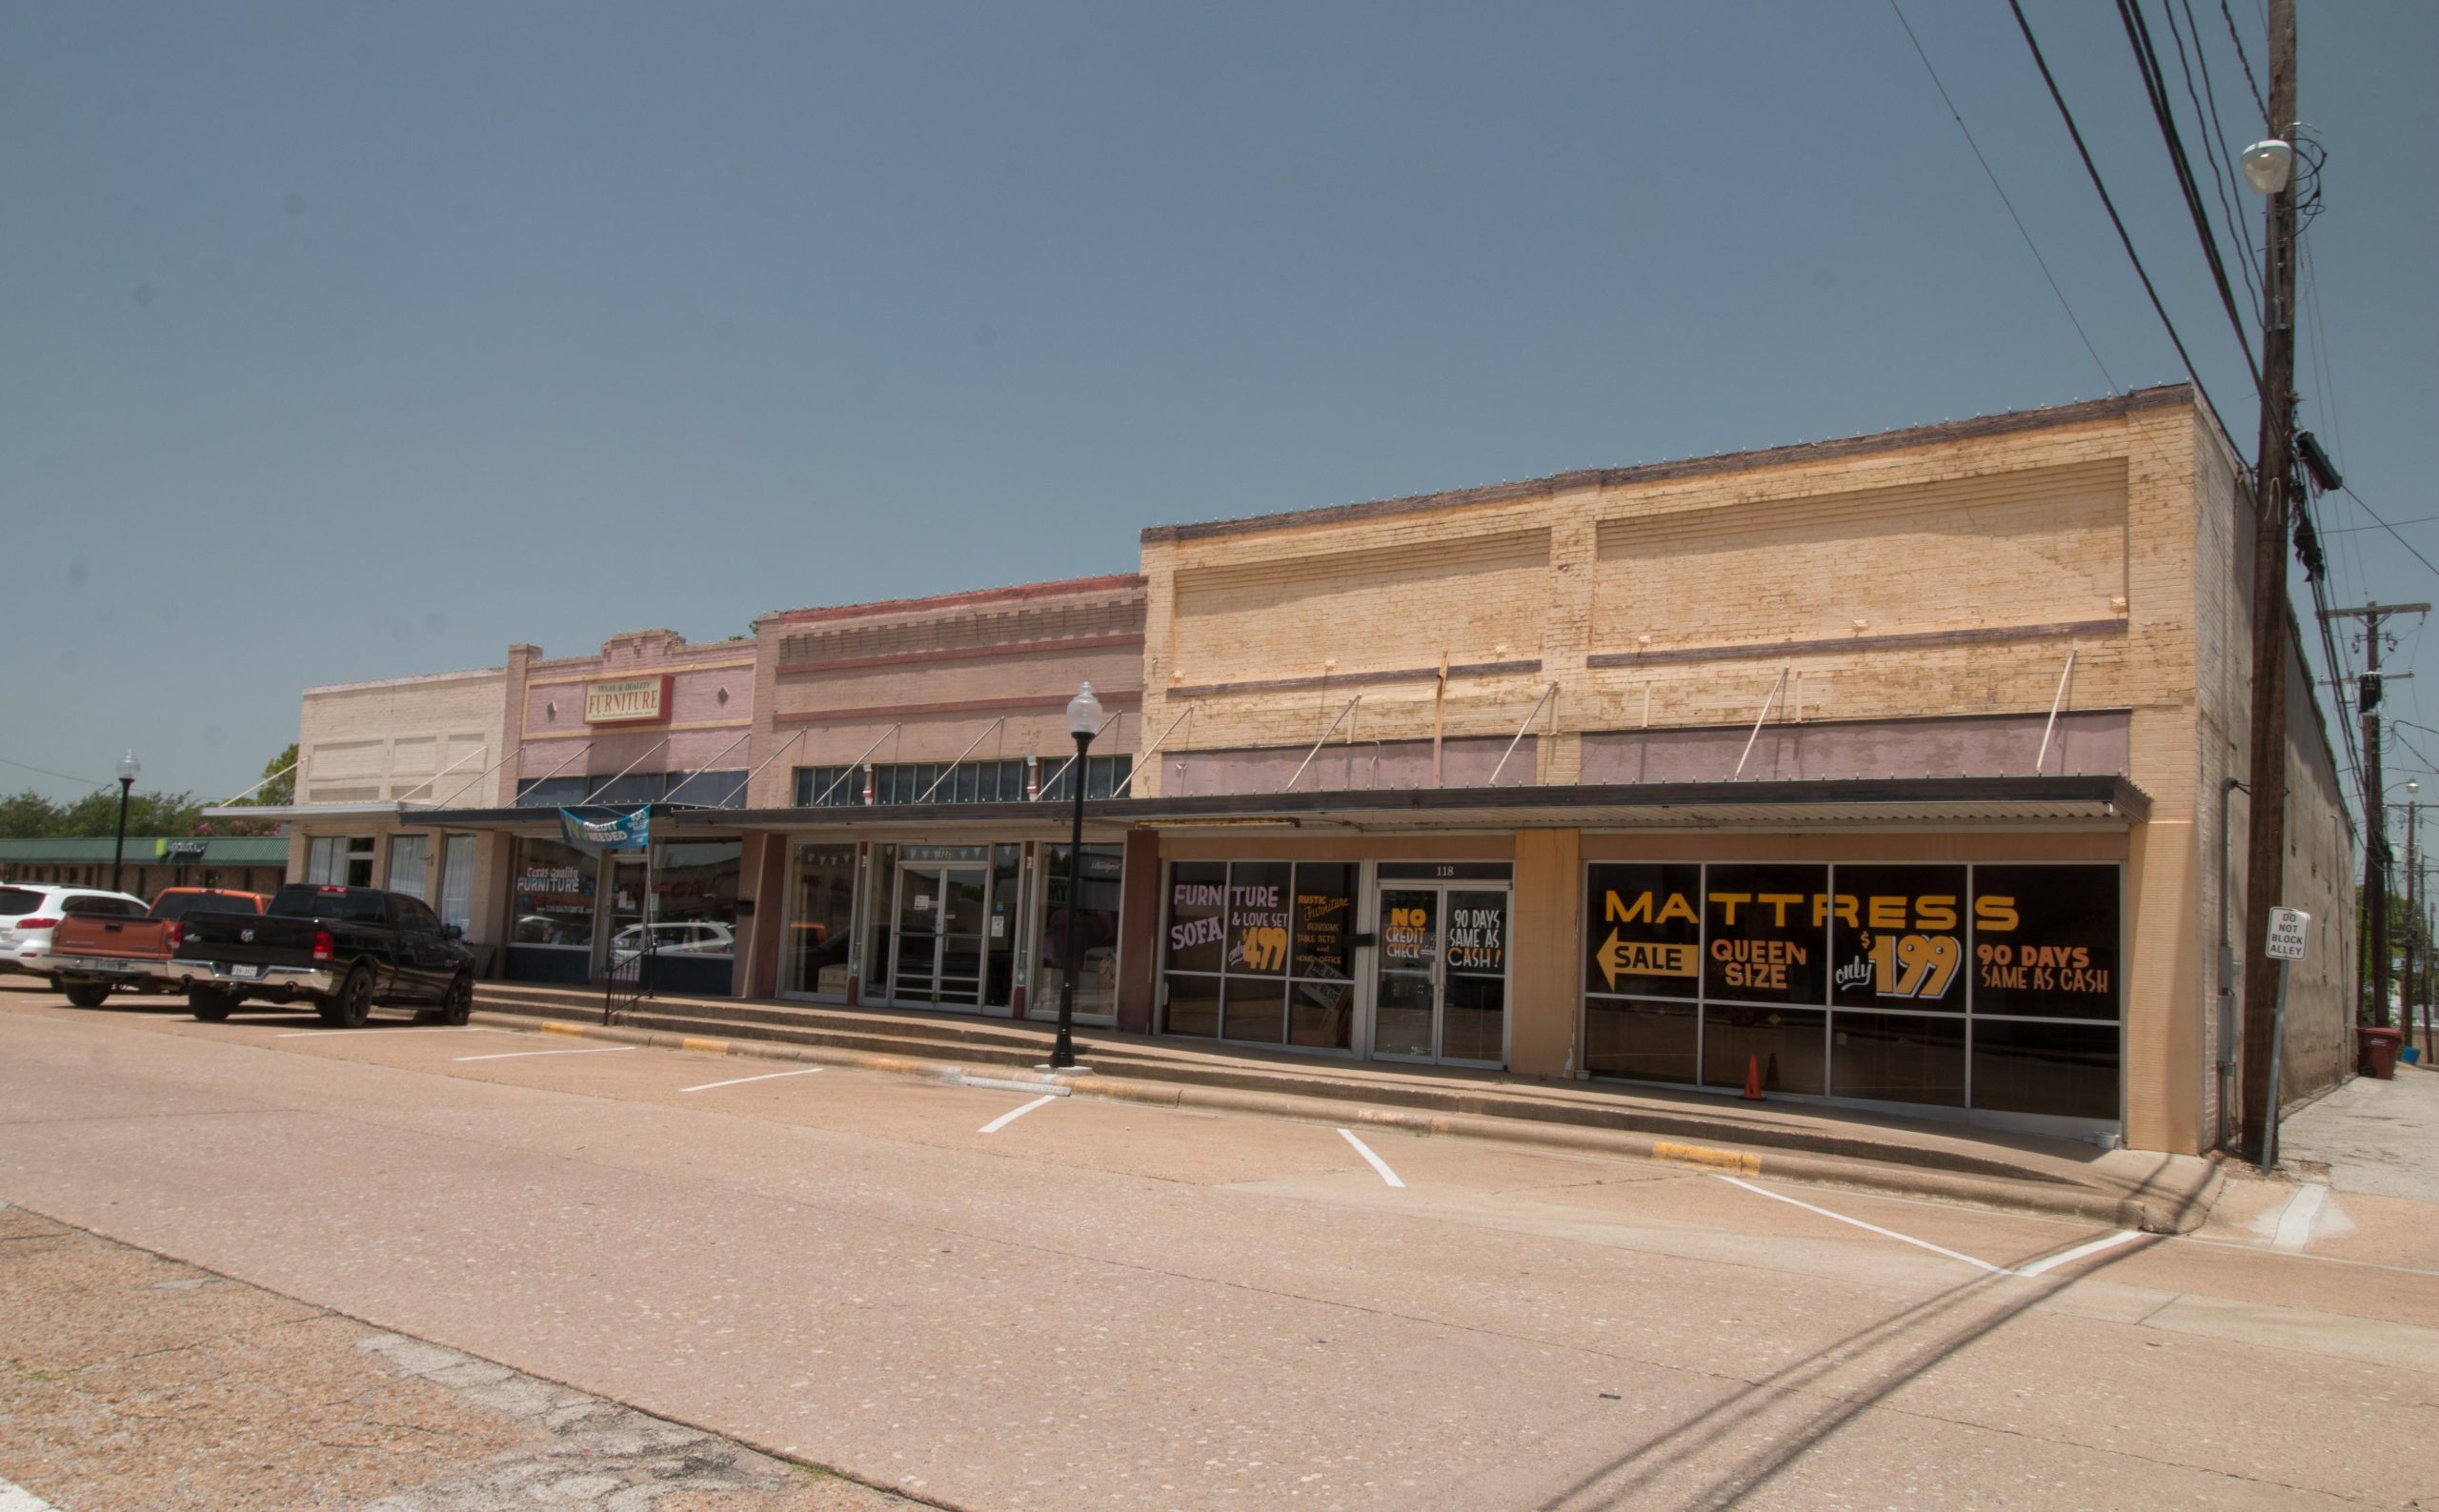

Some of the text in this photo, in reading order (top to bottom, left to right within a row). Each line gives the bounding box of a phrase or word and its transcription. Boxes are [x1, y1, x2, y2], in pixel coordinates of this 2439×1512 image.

[589, 690, 657, 714] FURNITURE
[588, 830, 629, 842] NEEDED
[1435, 865, 1455, 877] 118
[516, 877, 580, 893] FURNITURE
[1298, 895, 1327, 905] RUSTIC
[1304, 897, 1350, 921] Furniture
[1391, 908, 1427, 927] NO
[1454, 909, 1501, 929] 90 DAYS
[1605, 890, 2020, 932] MATTRESS
[2282, 913, 2296, 923] DO
[1171, 912, 1289, 951] SOFA & LOVE SET
[1385, 926, 1426, 944] CREDIT
[1449, 928, 1501, 949] SAME AS
[2278, 923, 2298, 934] NOT
[1241, 926, 1288, 971] $499
[1296, 934, 1336, 944] TABLE SETS
[2271, 934, 2303, 945] BLOCK
[1386, 943, 1420, 958] CHECK
[1613, 945, 1683, 973] SALE
[1710, 938, 1807, 966] QUEEN
[1976, 944, 2090, 969] 90 DAYS
[2269, 944, 2303, 956] ALLEY
[1724, 962, 1788, 989] SIZE
[1835, 955, 1875, 991] only
[1982, 965, 2108, 994] SAME AS CASH
